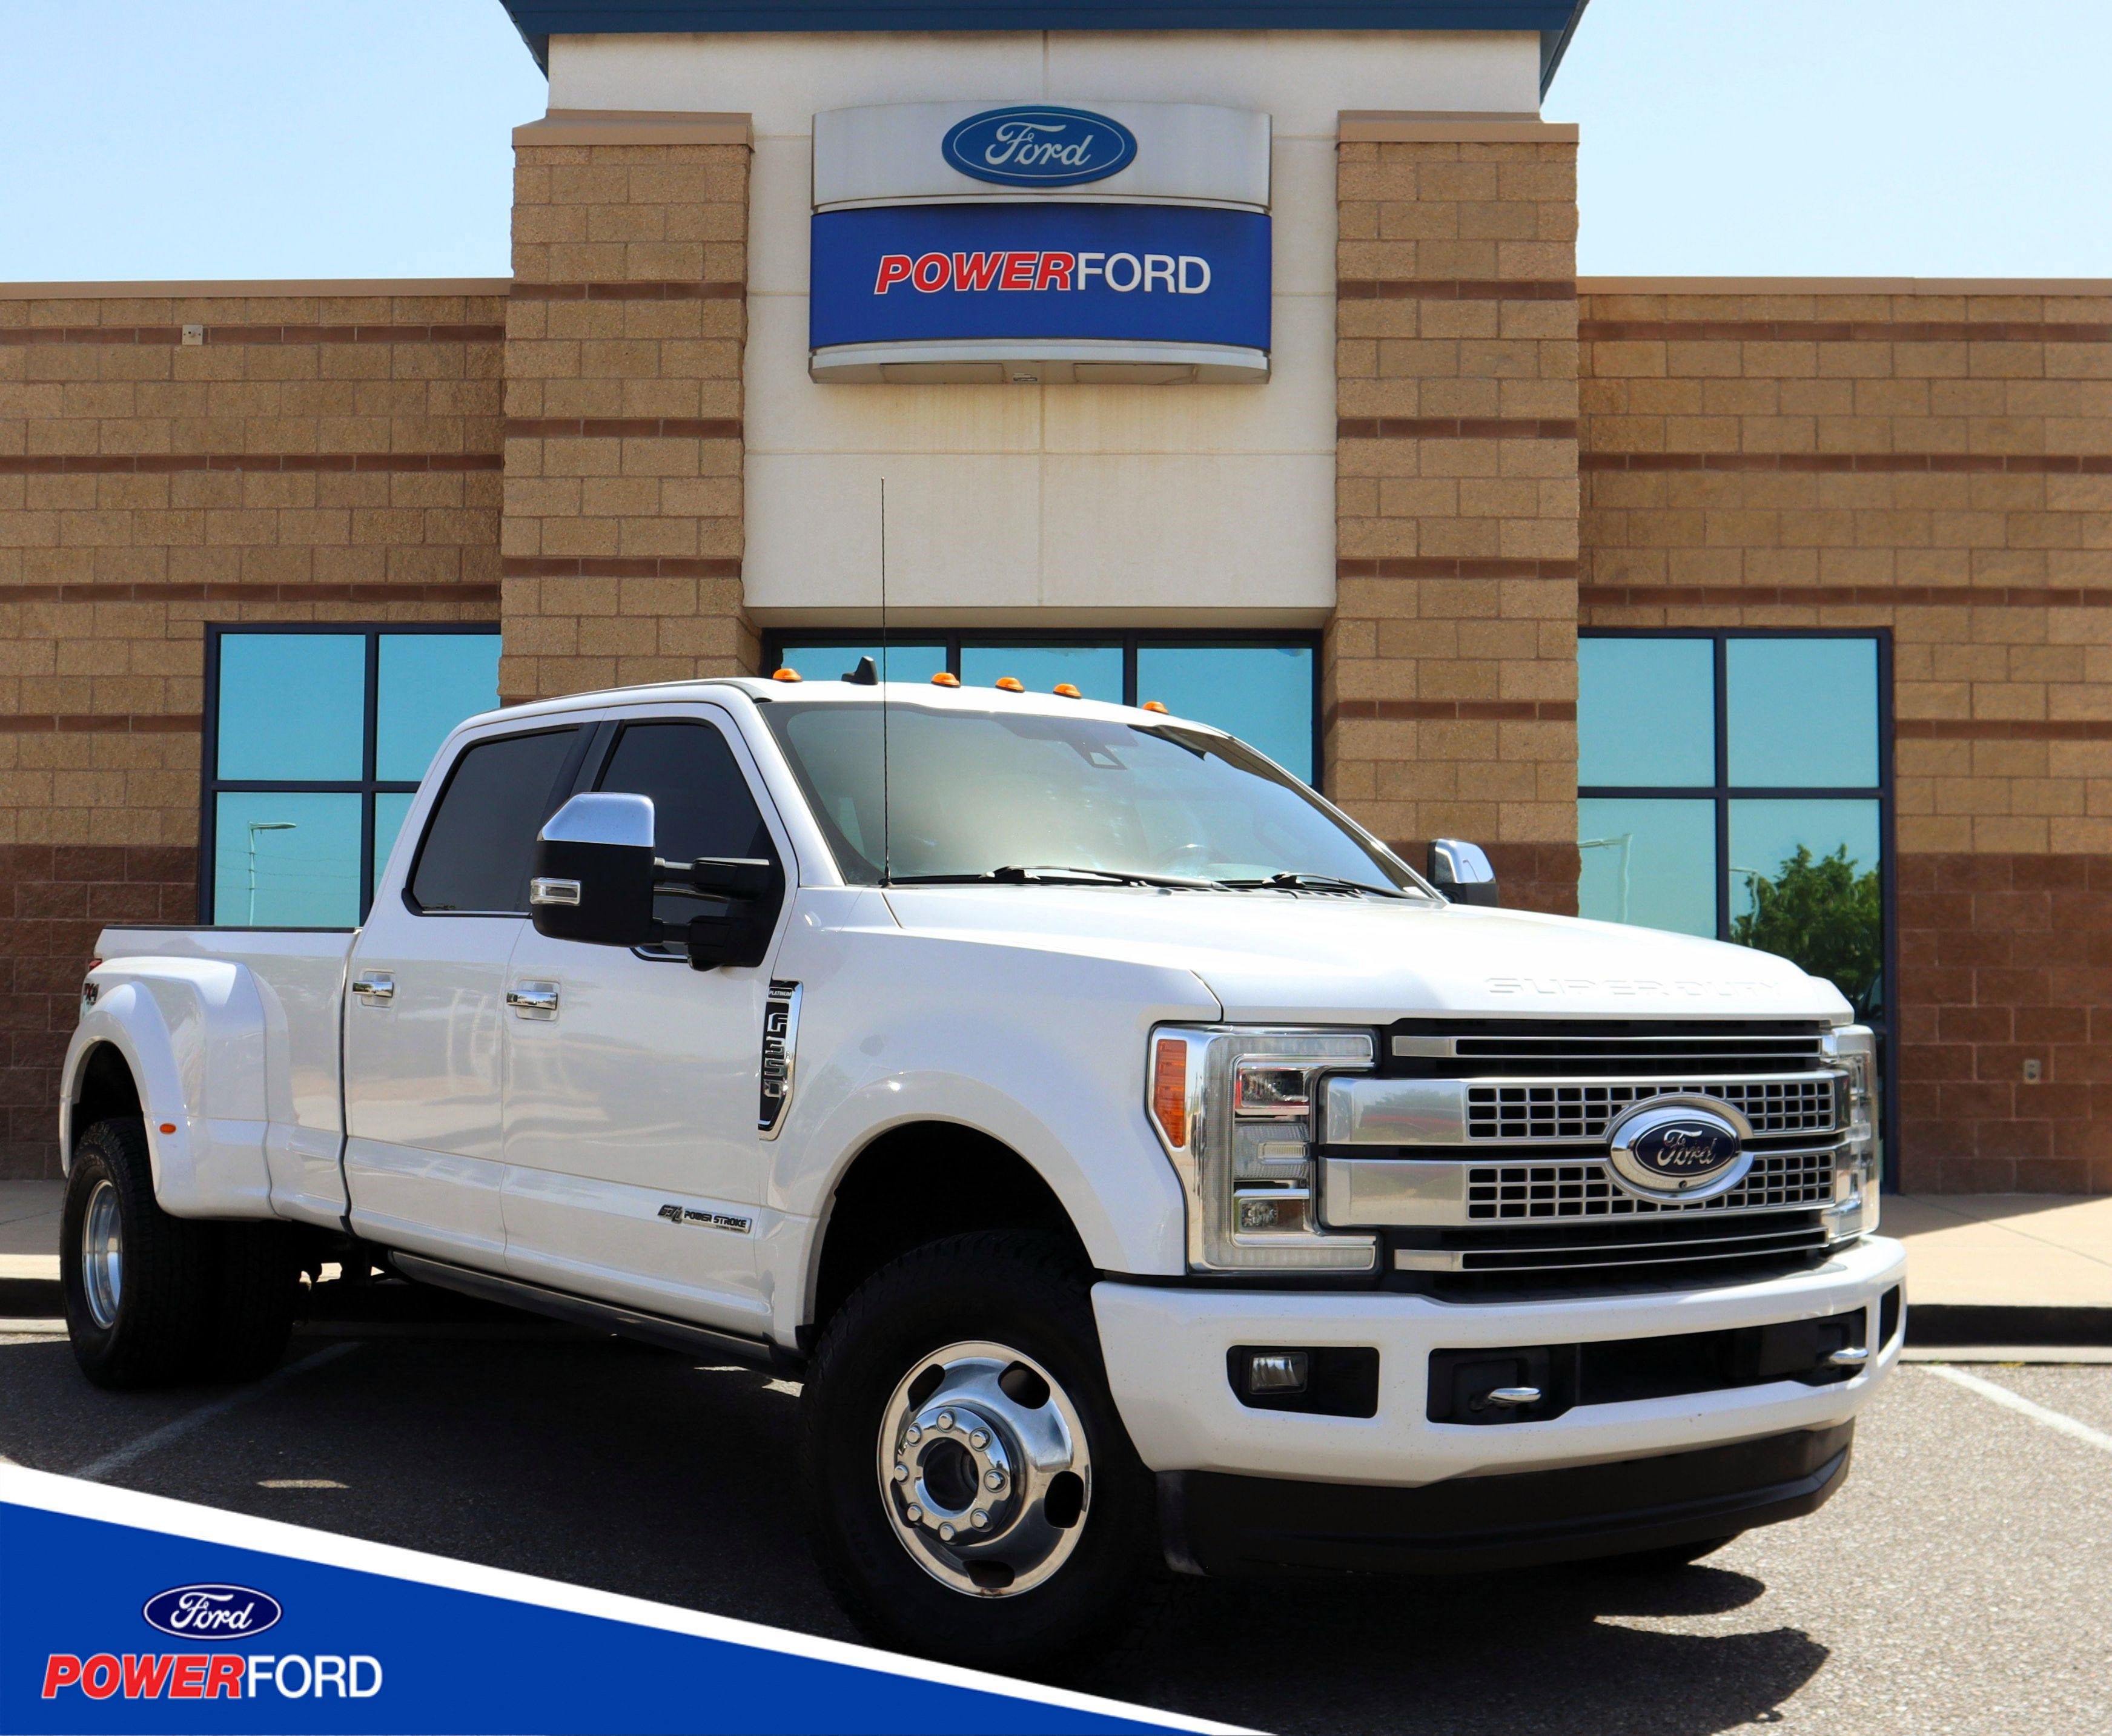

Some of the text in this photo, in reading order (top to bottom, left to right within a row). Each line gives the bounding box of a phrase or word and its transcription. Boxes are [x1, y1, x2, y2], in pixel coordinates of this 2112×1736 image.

[984, 121, 1094, 167] Ford
[769, 988, 793, 997] PLATINUM
[1485, 978, 1670, 996] SUPER
[1657, 1129, 1718, 1166] Ford
[684, 1210, 712, 1223] POWER
[713, 1215, 747, 1228] STROKE
